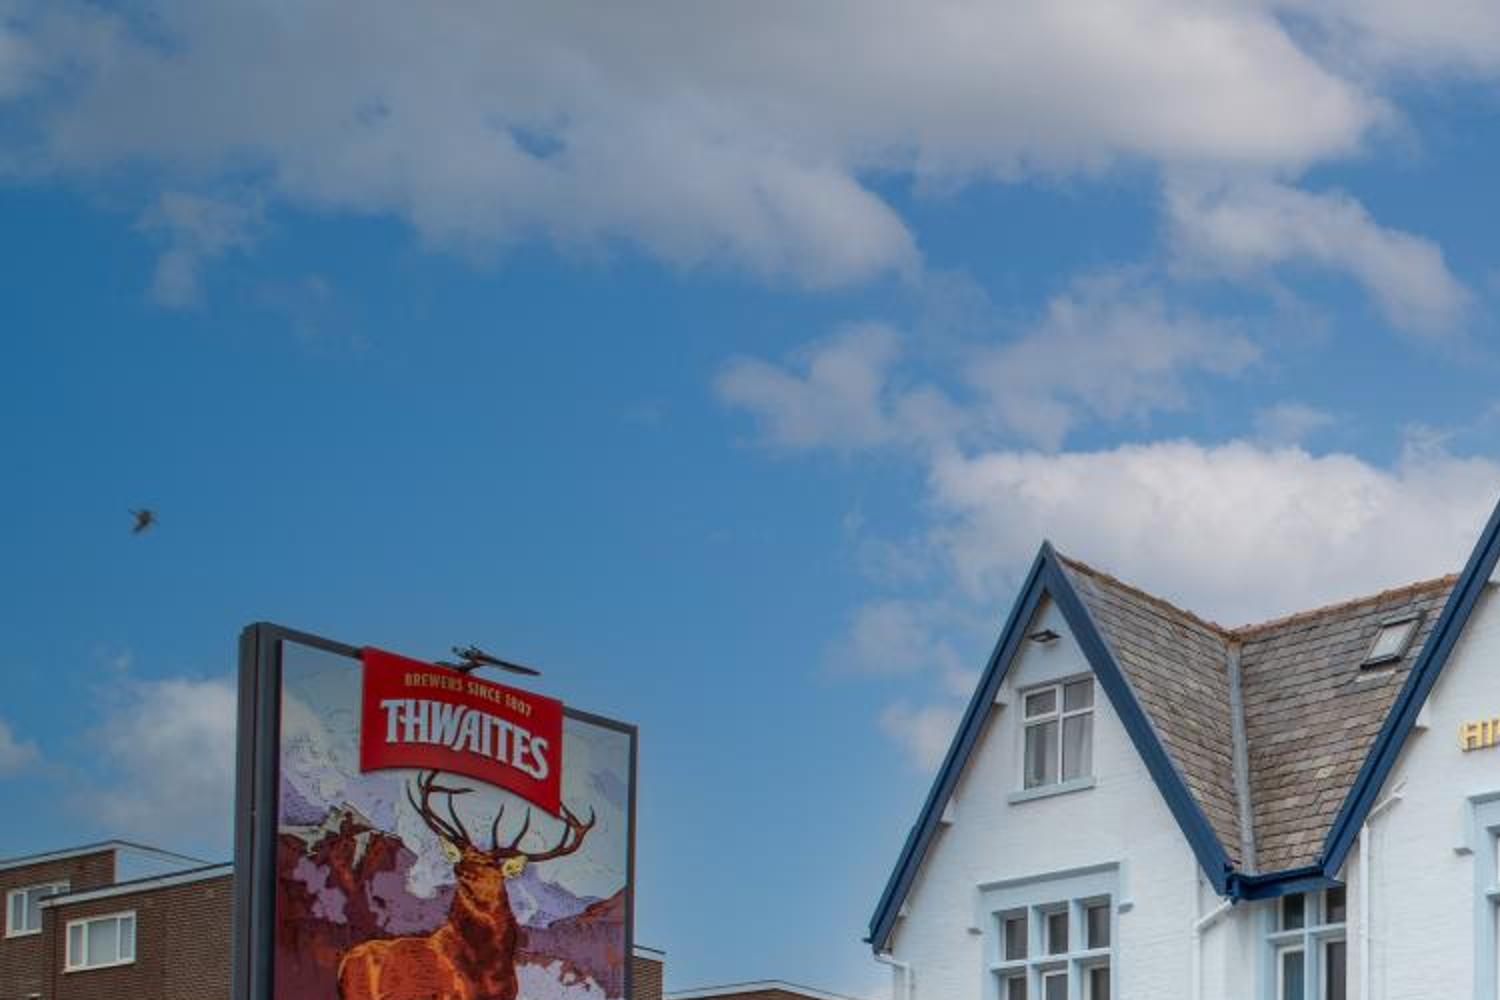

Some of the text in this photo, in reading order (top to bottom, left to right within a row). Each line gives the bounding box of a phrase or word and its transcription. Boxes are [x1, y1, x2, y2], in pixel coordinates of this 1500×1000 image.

[405, 672, 463, 691] BREWERS
[467, 681, 501, 702] SINCE
[379, 699, 548, 780] THWAITES
